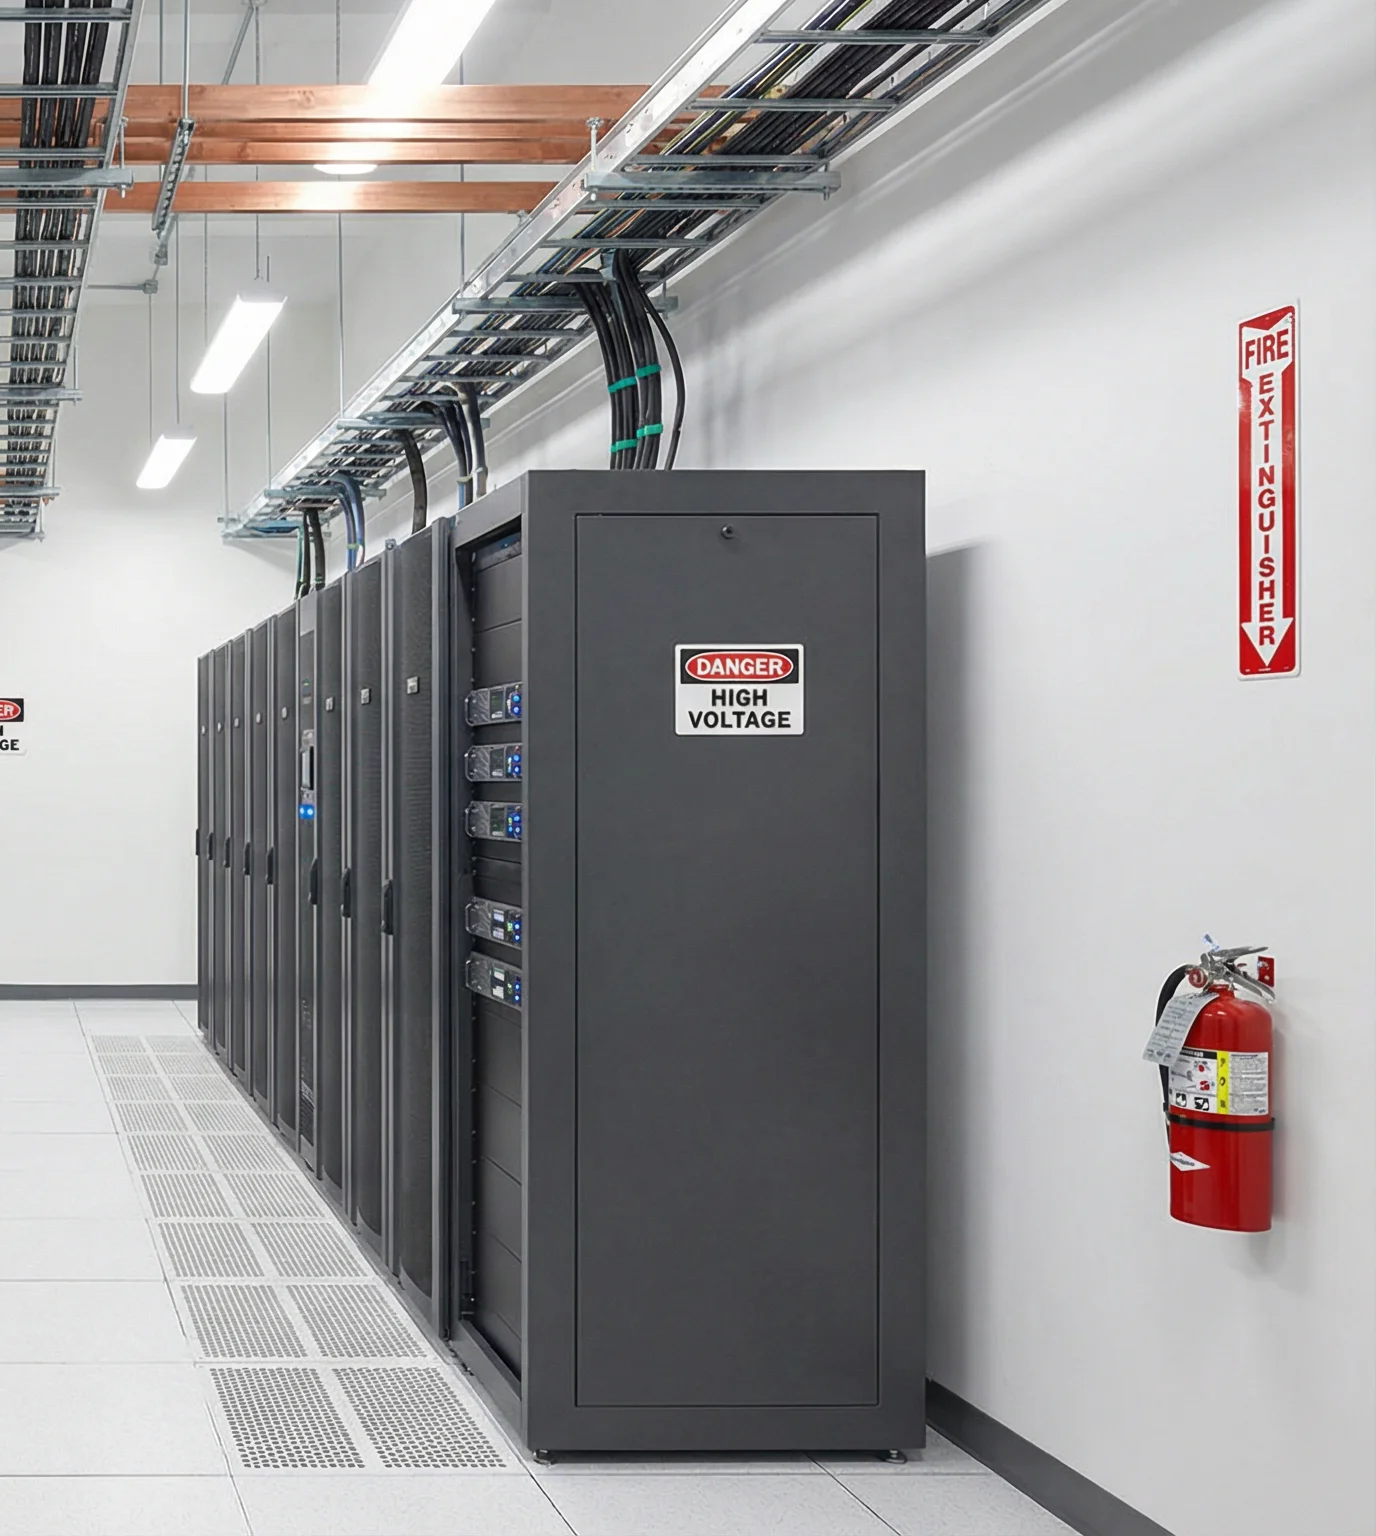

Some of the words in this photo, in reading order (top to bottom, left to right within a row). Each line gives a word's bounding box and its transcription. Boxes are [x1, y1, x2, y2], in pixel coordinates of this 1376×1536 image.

[1245, 328, 1289, 370] FIRE
[1257, 371, 1277, 647] EXTINGUISHER
[696, 658, 784, 676] DANGER
[711, 688, 767, 706] HIGH
[688, 711, 791, 728] VOLTAGE
